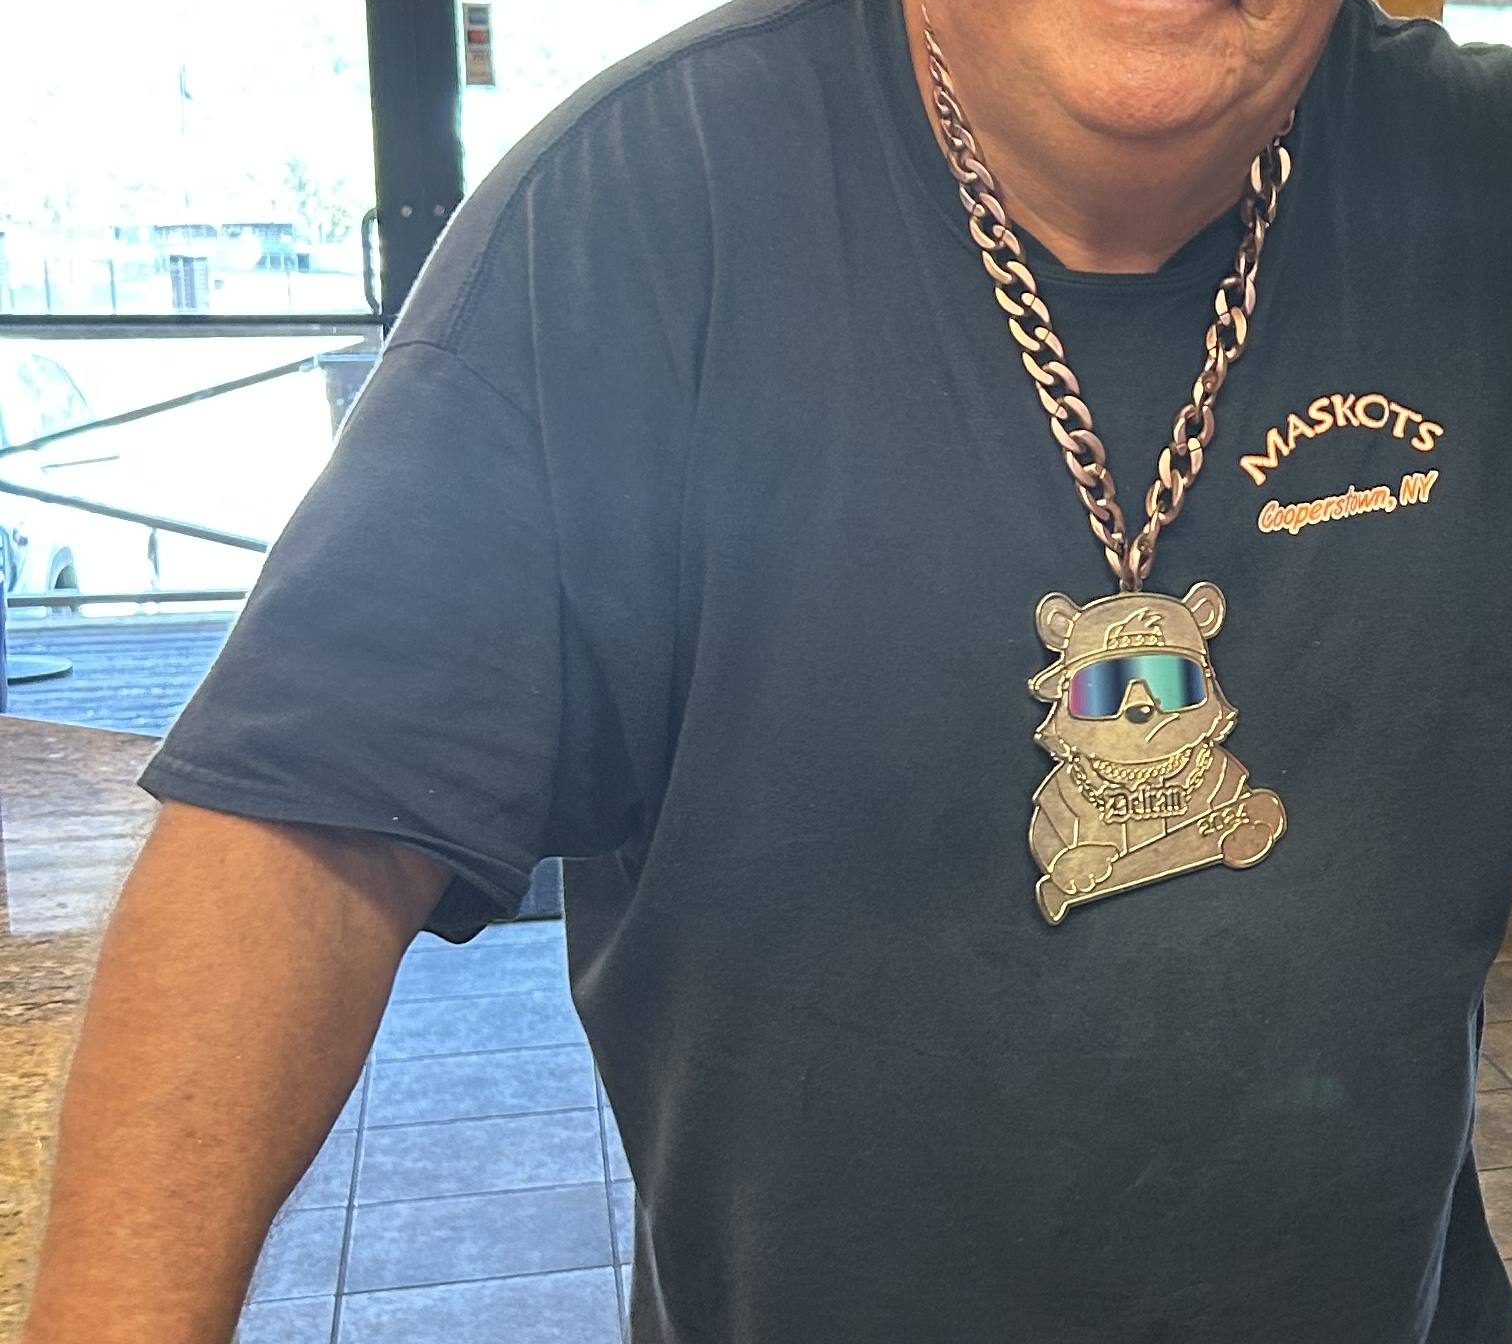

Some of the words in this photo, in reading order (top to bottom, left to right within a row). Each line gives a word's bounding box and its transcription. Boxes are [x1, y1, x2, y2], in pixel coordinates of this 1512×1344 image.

[1239, 392, 1445, 486] MASKOTS
[1258, 485, 1398, 535] Cooperstown,
[1400, 469, 1439, 506] NY
